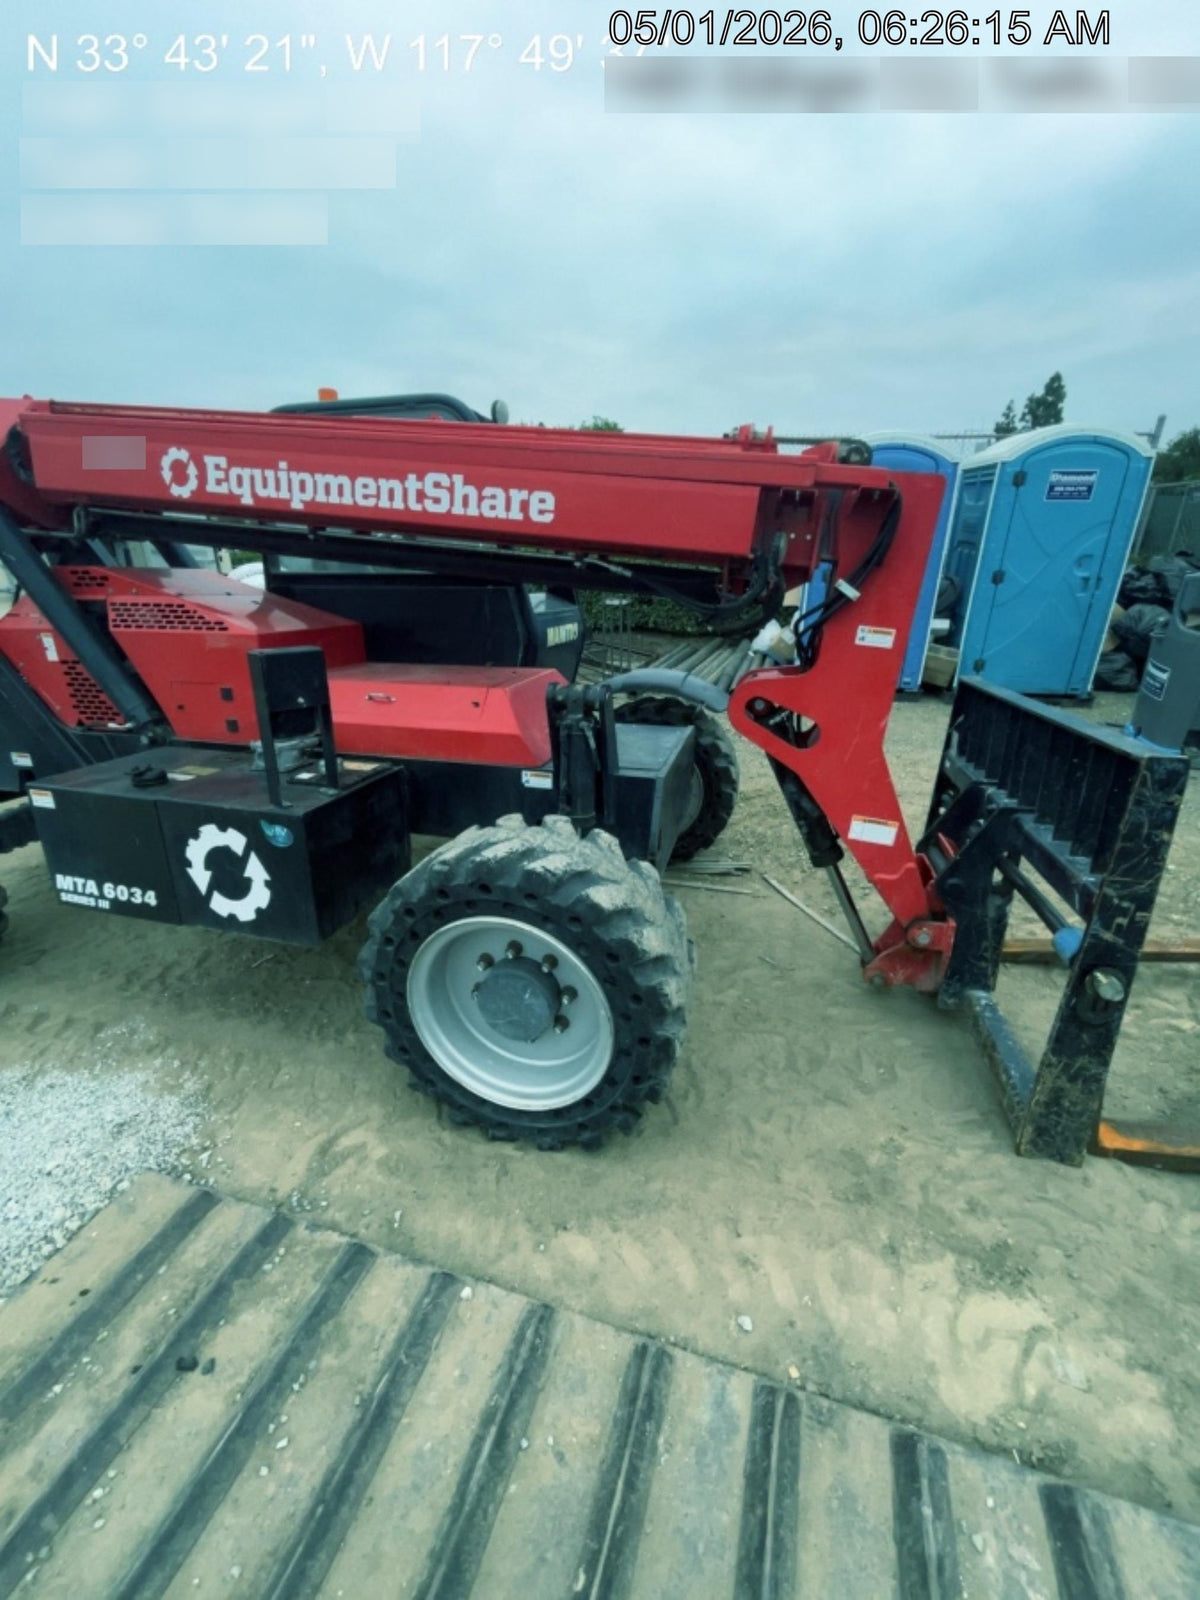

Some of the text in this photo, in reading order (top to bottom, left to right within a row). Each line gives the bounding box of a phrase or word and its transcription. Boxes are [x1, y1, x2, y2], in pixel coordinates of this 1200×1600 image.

[203, 455, 555, 523] EquipmentShare
[56, 874, 157, 907] MTA 6034
